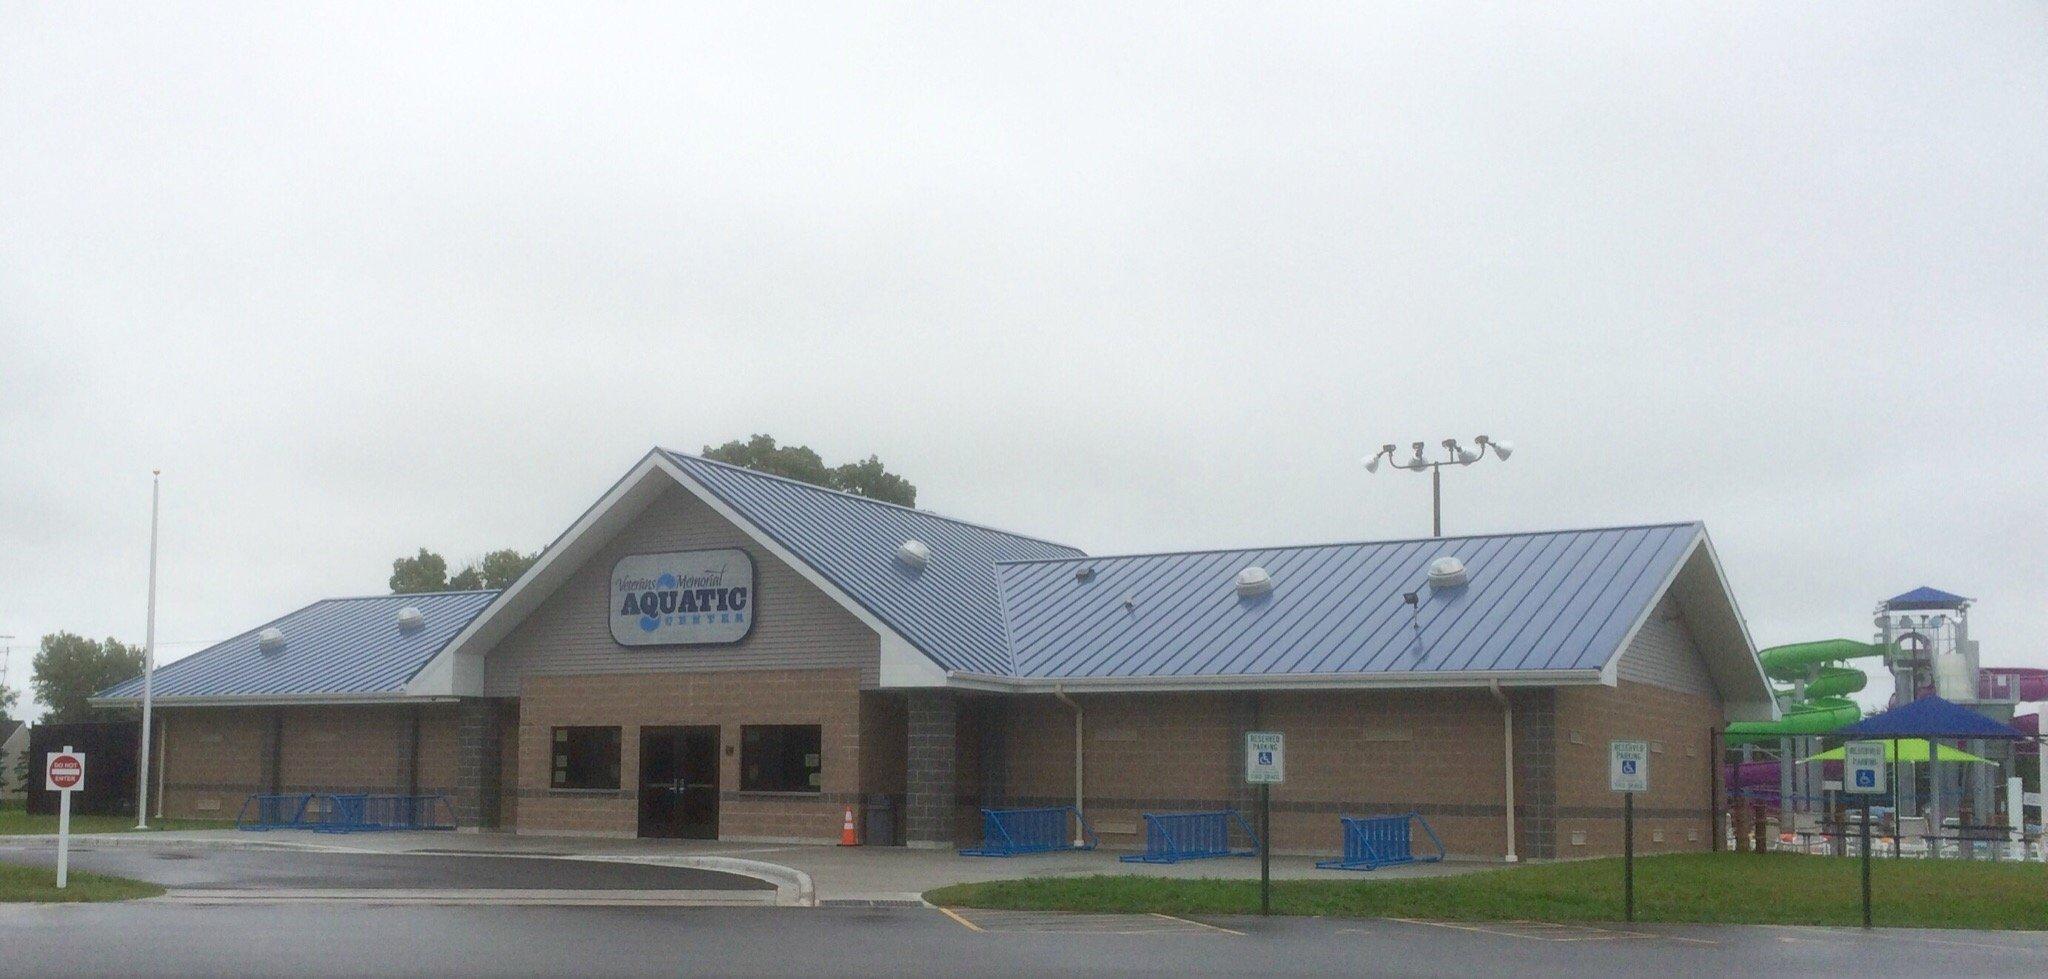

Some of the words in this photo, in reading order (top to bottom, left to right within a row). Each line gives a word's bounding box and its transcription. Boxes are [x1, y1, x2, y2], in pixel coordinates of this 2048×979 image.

[617, 574, 656, 591] Veterans
[676, 564, 727, 588] Memorial
[621, 587, 747, 618] AQUATIC
[665, 613, 744, 626] CENTER
[1250, 734, 1280, 743] RESERVED
[1252, 743, 1279, 751] PARKING
[1614, 743, 1645, 751] RESERVED
[1616, 751, 1642, 760] PARKING
